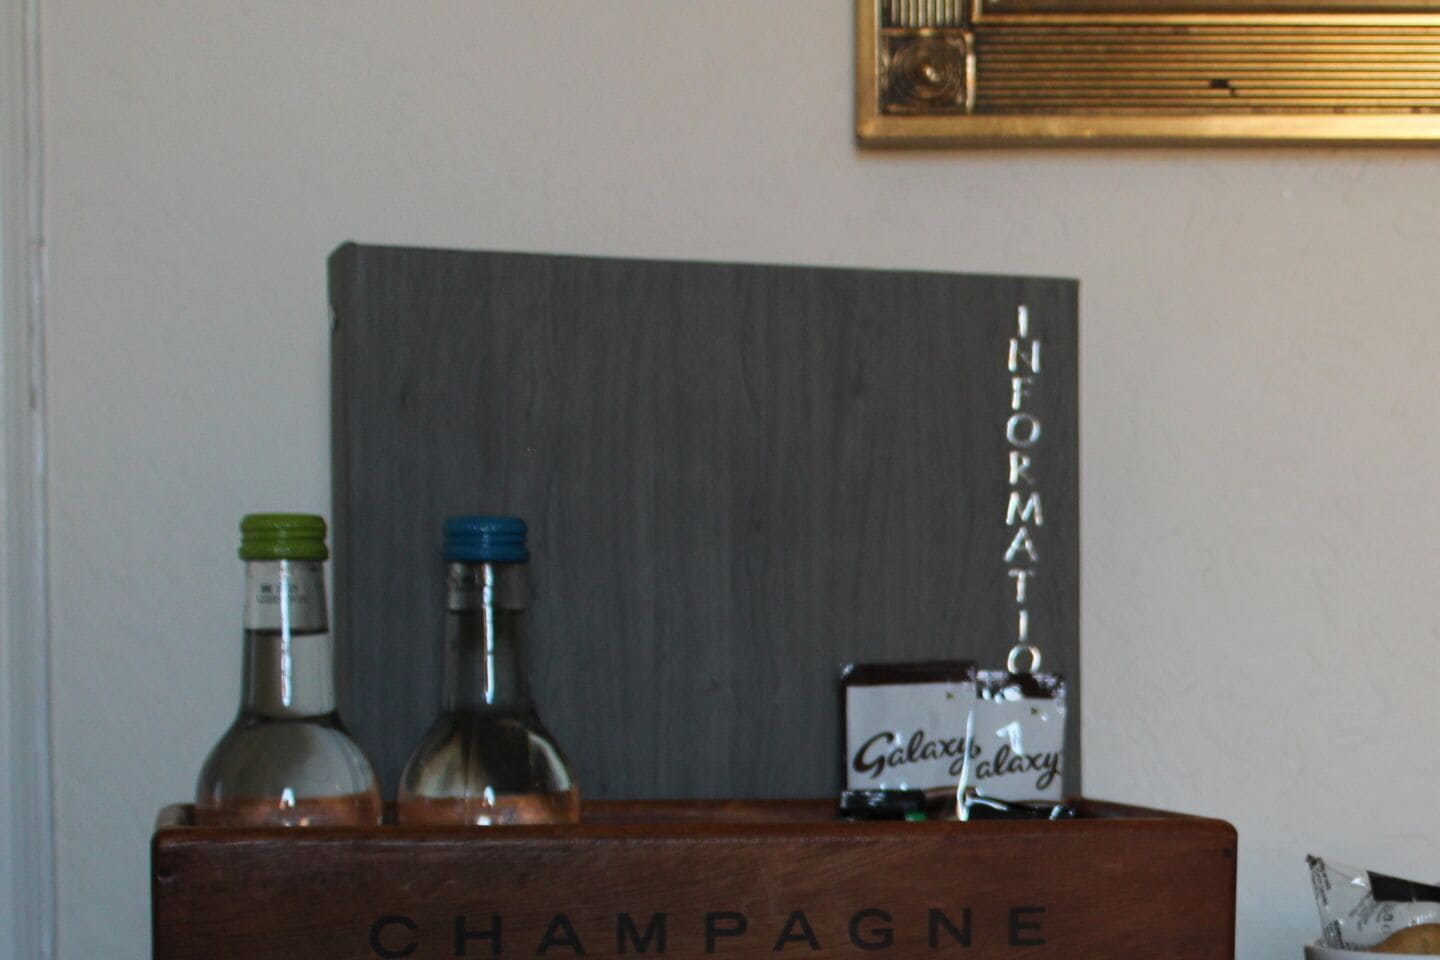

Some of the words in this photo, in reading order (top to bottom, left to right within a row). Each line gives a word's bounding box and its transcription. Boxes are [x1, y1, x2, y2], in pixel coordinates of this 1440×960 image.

[1004, 305, 1043, 674] INFORMATIO
[853, 729, 981, 778] Galaxy
[976, 744, 1062, 791] alaxy
[369, 906, 1046, 960] CHAMPAGNE
